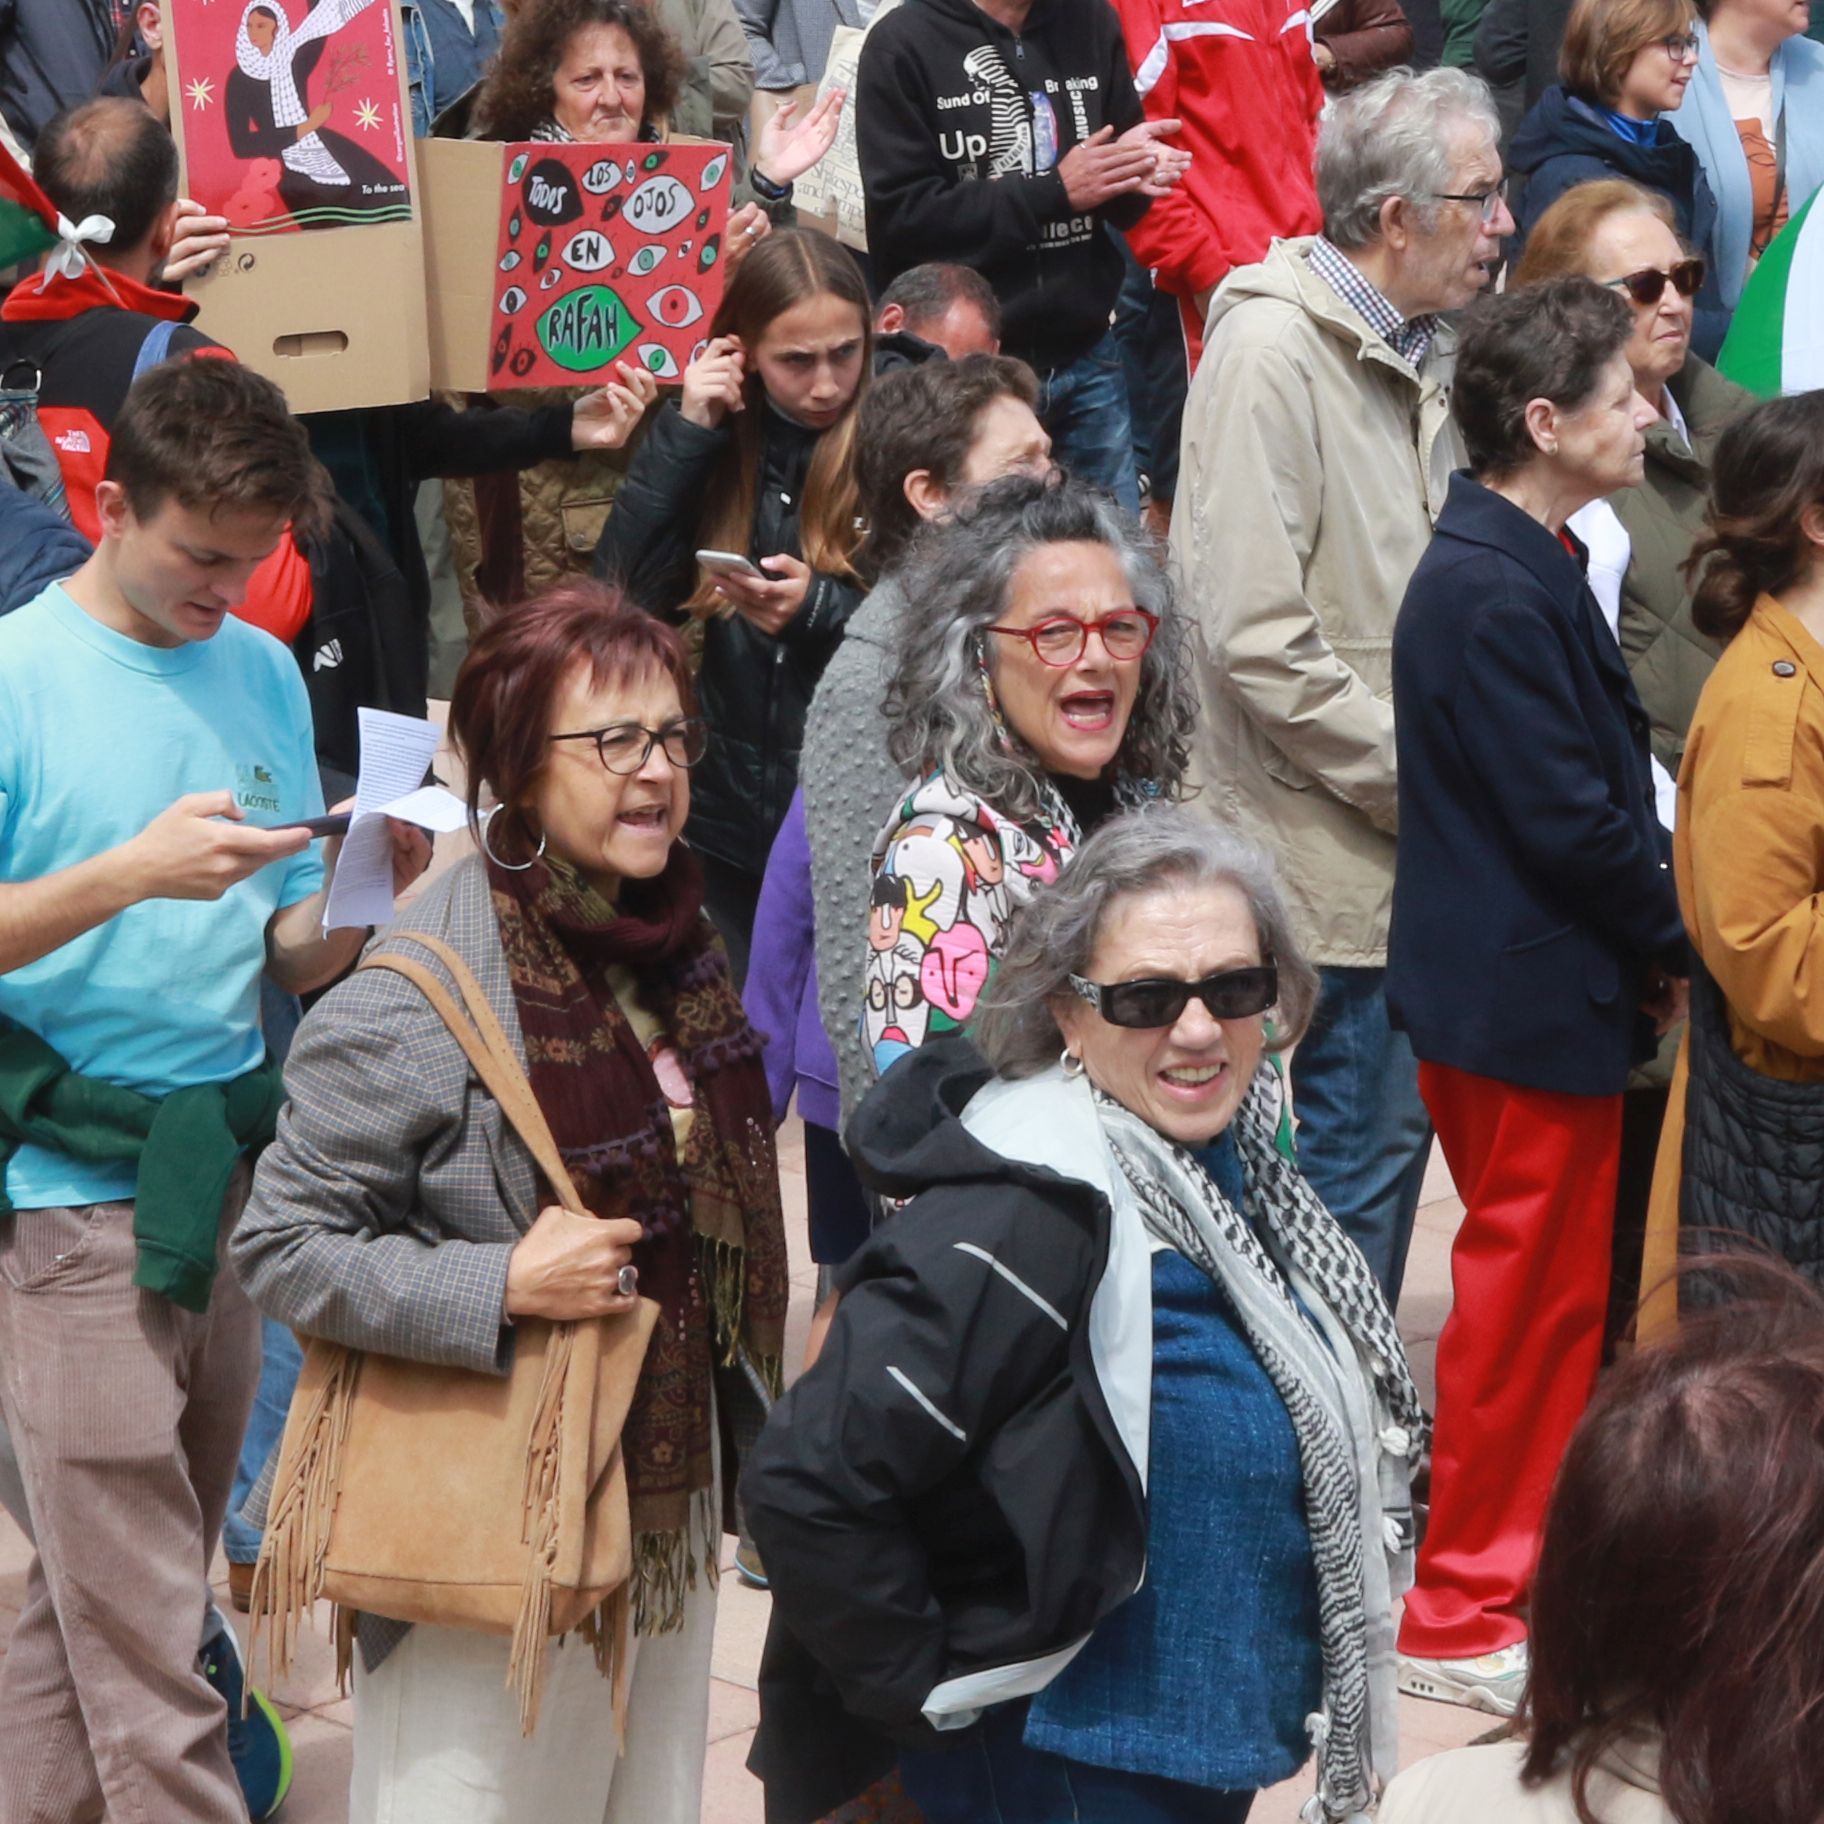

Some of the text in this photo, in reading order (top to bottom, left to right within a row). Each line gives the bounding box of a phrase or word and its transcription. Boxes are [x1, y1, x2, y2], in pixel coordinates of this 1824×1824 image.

[938, 129, 988, 163] Up
[361, 183, 405, 195] To the sea
[587, 162, 612, 187] LOS
[528, 175, 568, 215] TODOS
[633, 182, 679, 221] OJOS
[570, 235, 601, 264] EN
[548, 292, 619, 354] RAFAH
